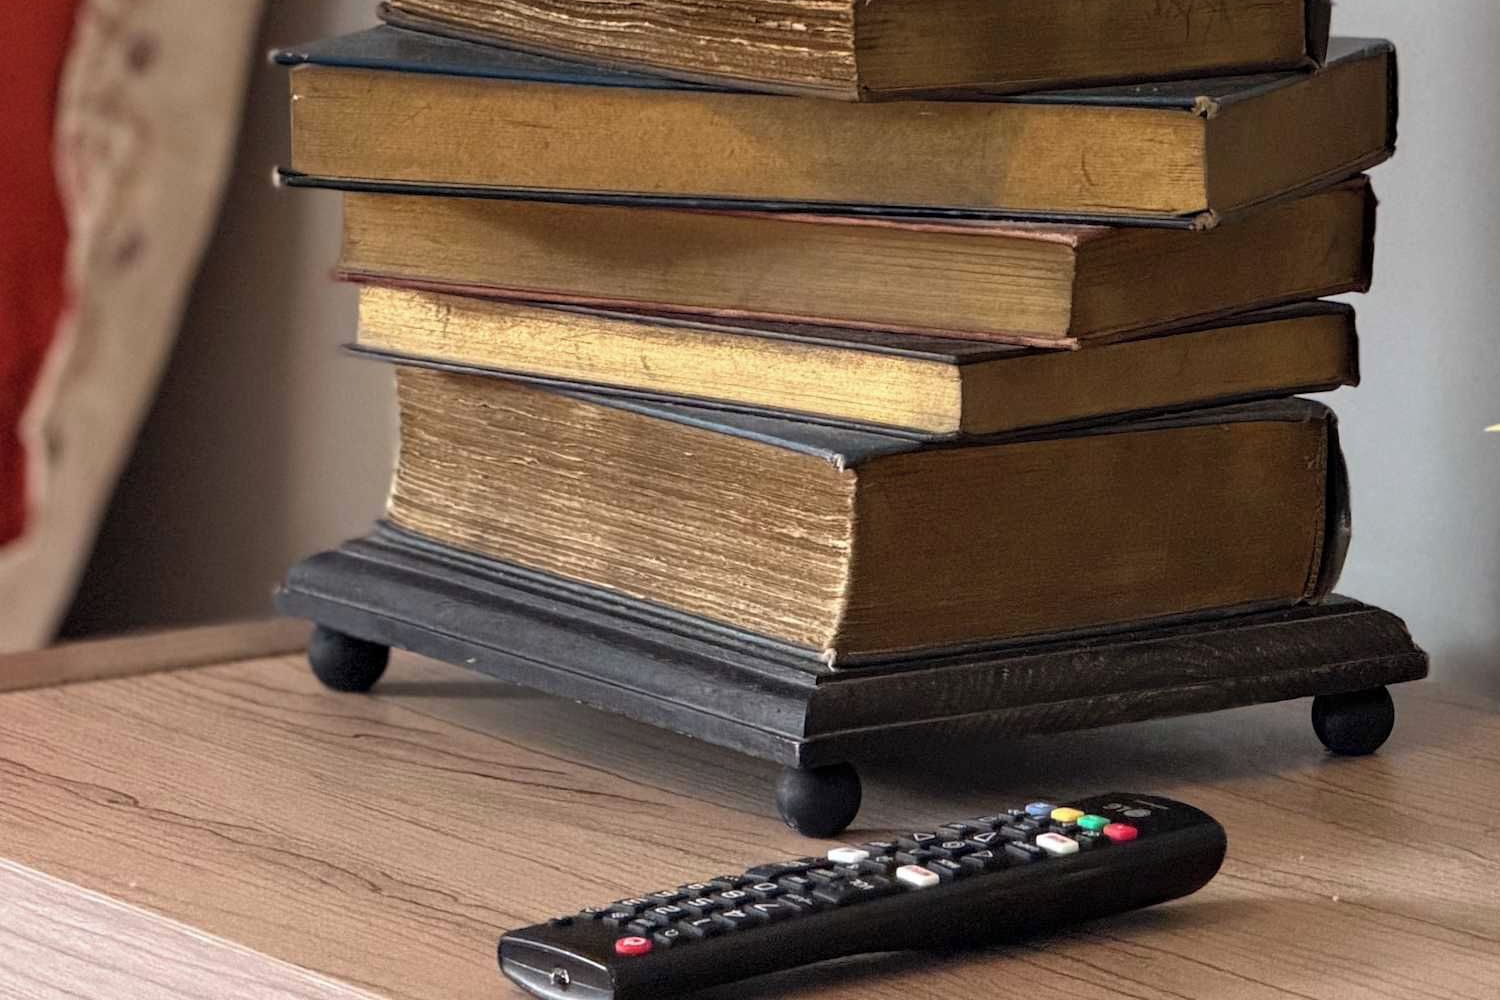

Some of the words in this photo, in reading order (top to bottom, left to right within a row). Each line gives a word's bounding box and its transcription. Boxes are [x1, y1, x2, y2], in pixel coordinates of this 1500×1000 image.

[721, 890, 746, 899] 8
[688, 898, 714, 907] 5
[655, 905, 682, 915] 2
[753, 904, 780, 912] 7
[723, 909, 746, 917] 4
[692, 918, 712, 926] 1
